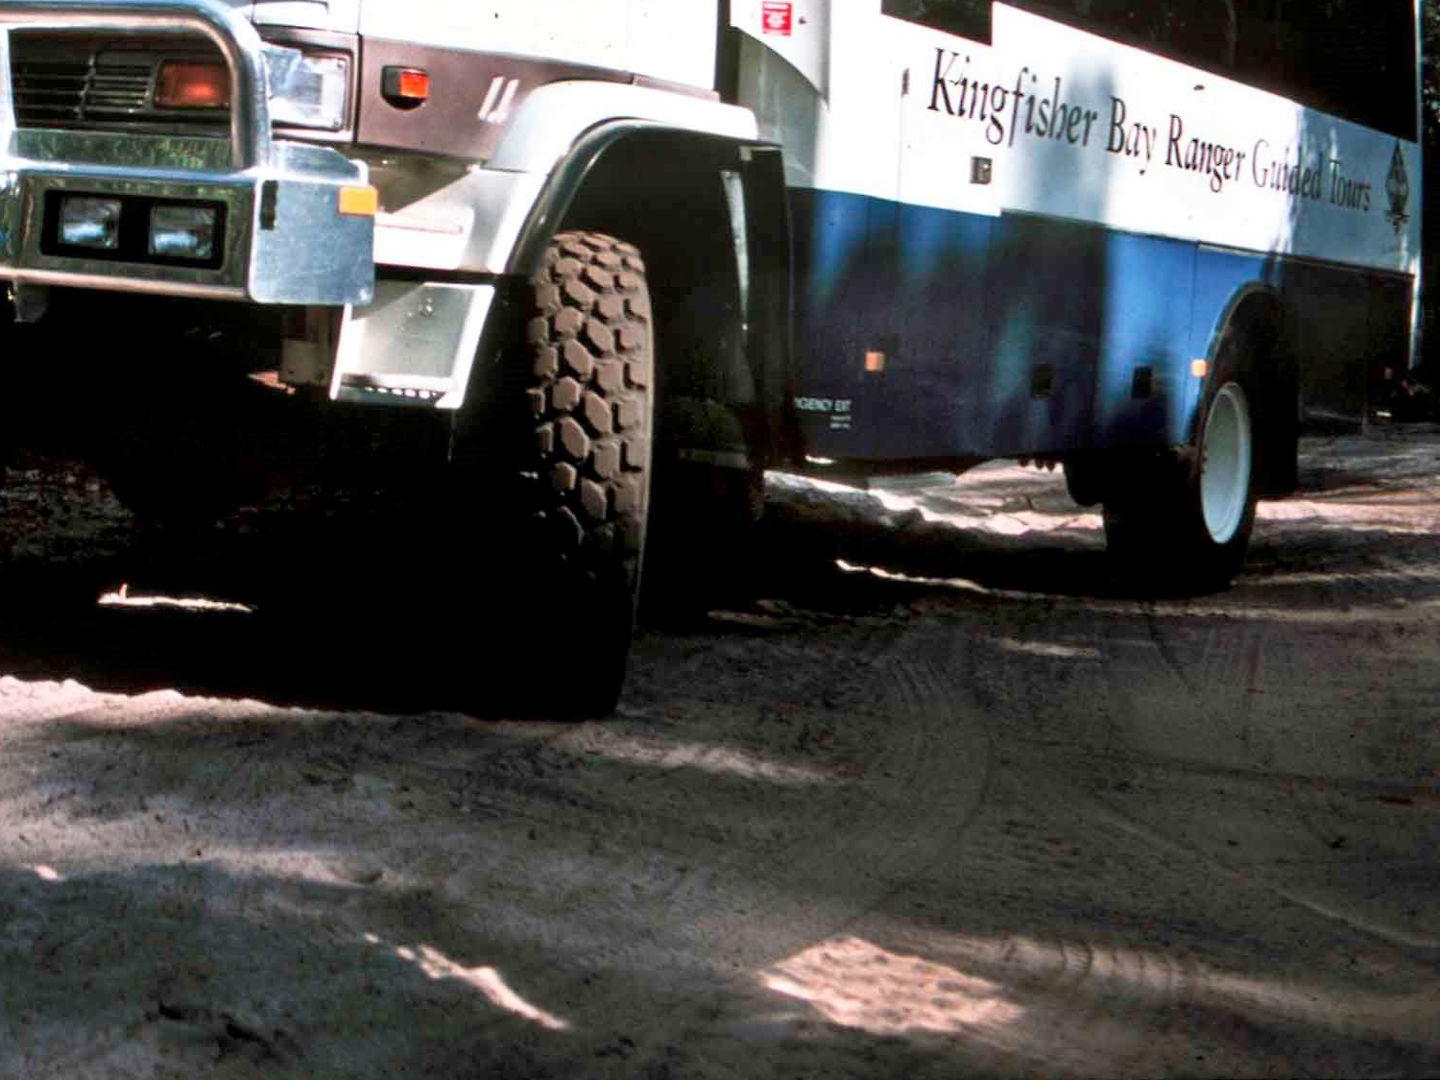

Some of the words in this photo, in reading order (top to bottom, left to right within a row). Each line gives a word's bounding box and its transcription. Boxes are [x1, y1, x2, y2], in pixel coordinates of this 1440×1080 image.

[927, 48, 1098, 148] Kingfisher
[1106, 95, 1157, 175] Bay
[1165, 114, 1246, 193] Ranger
[1252, 139, 1322, 201] Guided
[1329, 158, 1372, 212] Tours
